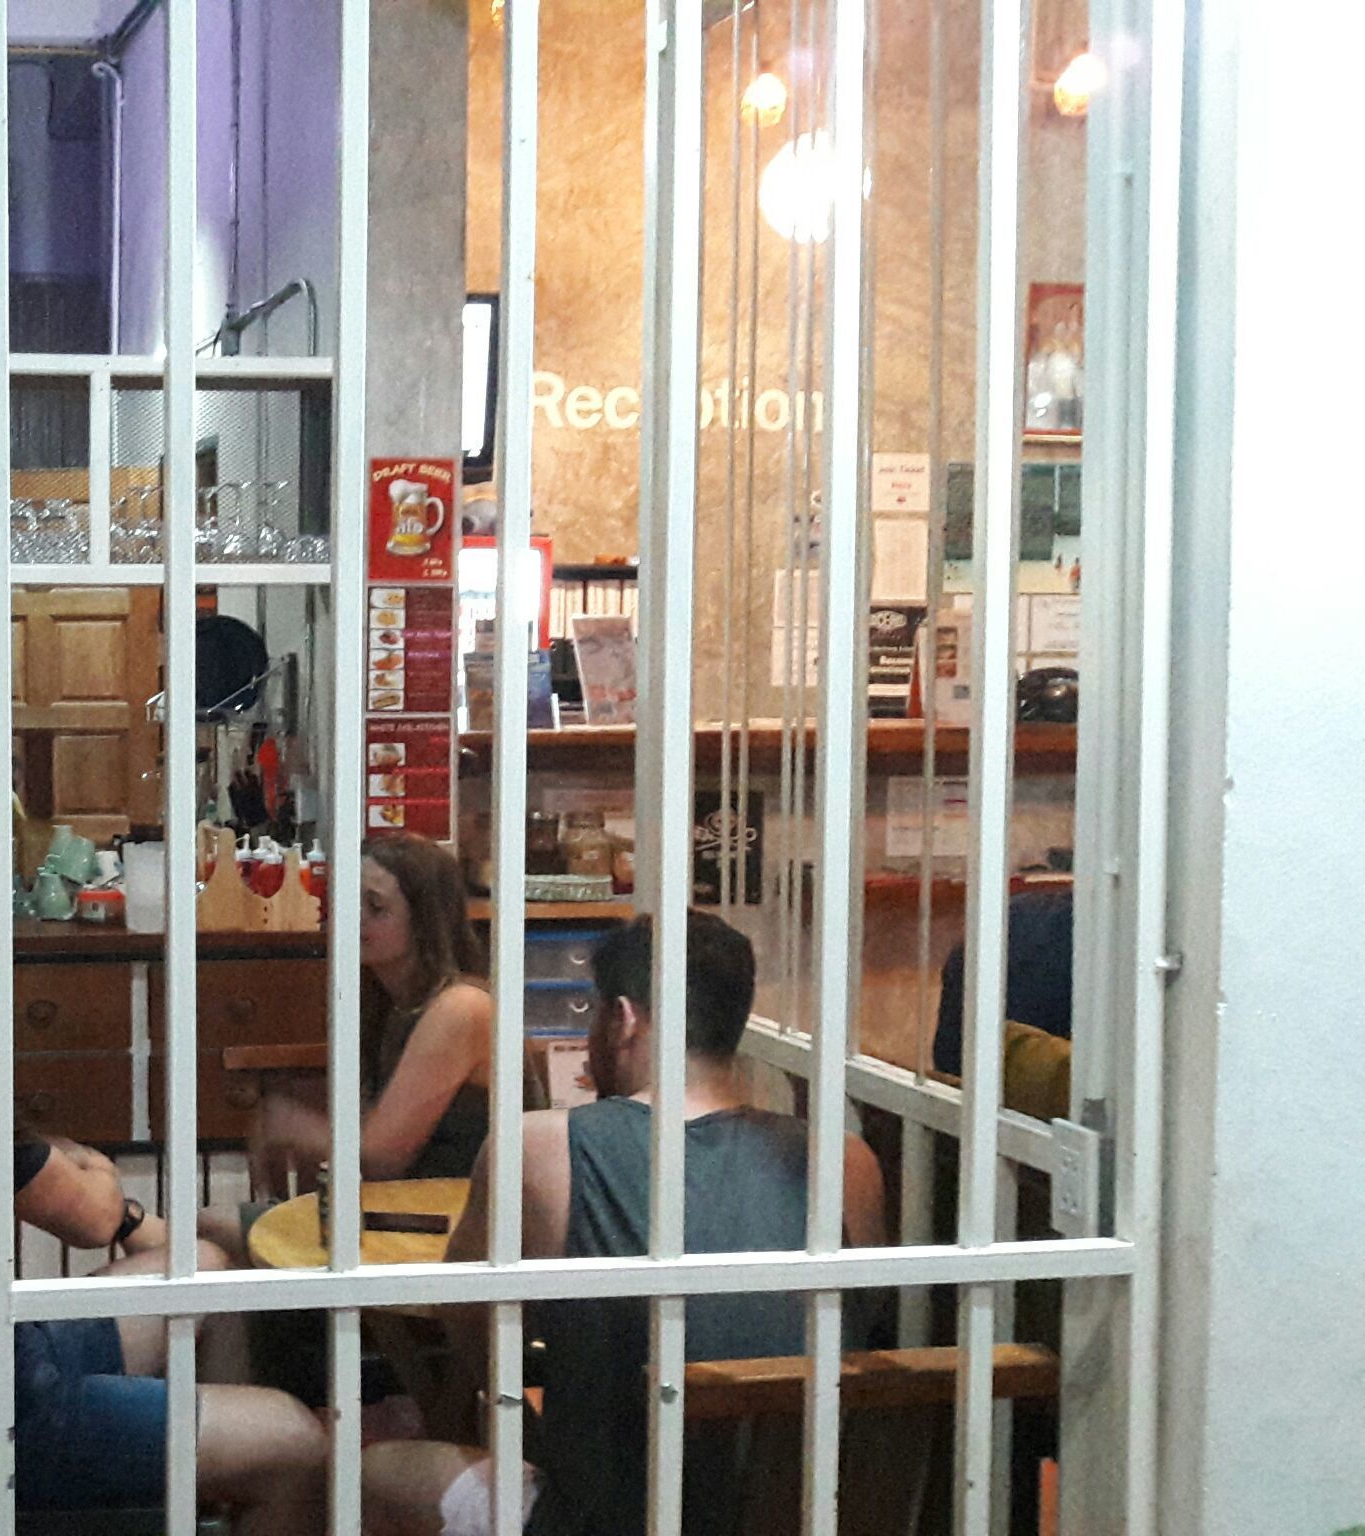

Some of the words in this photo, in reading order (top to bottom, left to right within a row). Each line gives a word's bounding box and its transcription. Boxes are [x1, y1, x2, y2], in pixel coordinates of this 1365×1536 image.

[533, 370, 825, 432] Rection
[373, 463, 416, 482] DRAFT
[418, 464, 451, 485] BEER
